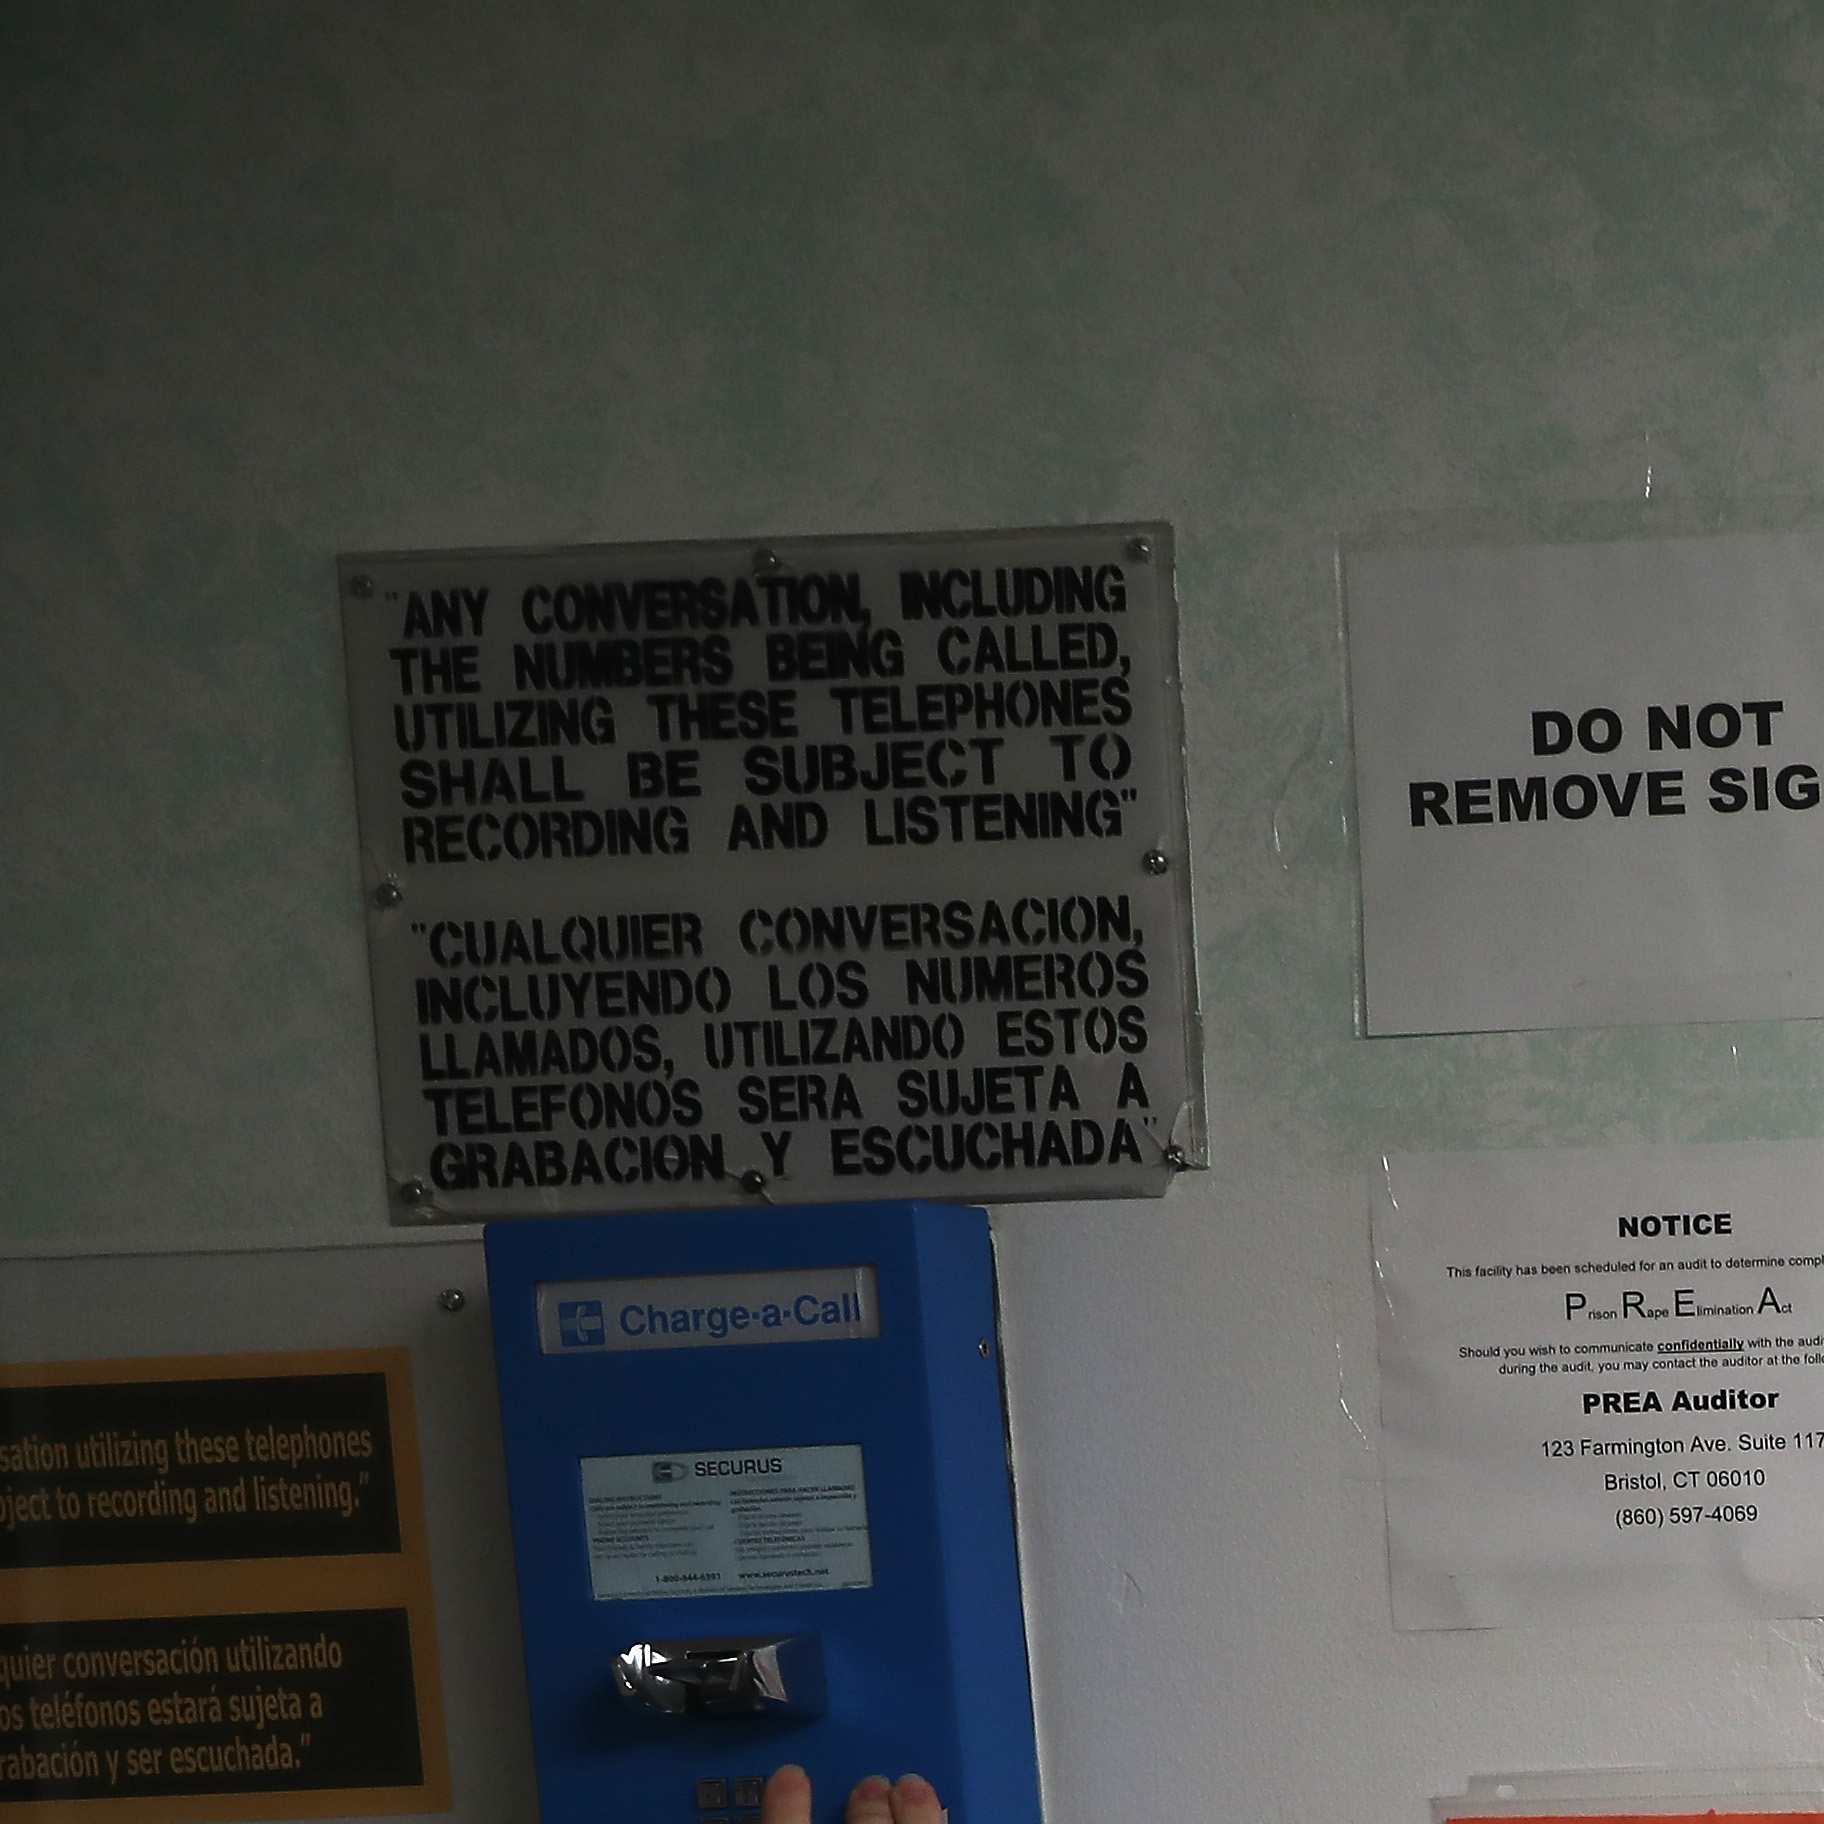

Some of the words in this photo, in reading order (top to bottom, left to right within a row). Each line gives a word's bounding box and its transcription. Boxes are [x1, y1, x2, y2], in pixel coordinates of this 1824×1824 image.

[521, 573, 870, 635] CONVERSATION,
[899, 564, 1126, 621] INCLUDING
[389, 645, 482, 696] THE
[513, 633, 734, 691] NUMBERS
[769, 630, 904, 682] BEING
[937, 621, 1130, 677] CALLED,
[393, 696, 616, 753] UTILIZING
[646, 689, 799, 742] THESE
[829, 677, 1132, 735] TELEPHONES
[1531, 708, 1622, 756] DO
[1647, 701, 1783, 751] NOT
[400, 755, 585, 810] SHALL
[627, 749, 702, 799] BE
[744, 737, 1004, 796] SUBJECT
[1049, 733, 1132, 782] TO
[1409, 770, 1686, 827] REMOVE
[402, 805, 690, 864] RECORDING
[727, 801, 828, 851] AND
[864, 788, 1137, 846] LISTENING"
[1619, 1213, 1732, 1238] NOTICE
[1446, 1266, 1472, 1278] This
[1475, 1265, 1513, 1279] facility
[1516, 1265, 1538, 1276] has
[1541, 1264, 1571, 1275] been
[1574, 1261, 1636, 1274] scheduled
[1639, 1260, 1656, 1271] for
[1659, 1262, 1674, 1271] an
[1677, 1258, 1707, 1270] audit
[1710, 1258, 1722, 1269] to
[1725, 1256, 1785, 1269] determine
[1566, 1293, 1617, 1320] Prison
[1622, 1291, 1669, 1320] Rape
[1674, 1289, 1754, 1317] Elimination
[1757, 1287, 1792, 1314] Act
[1583, 1391, 1663, 1414] PREA
[1671, 1389, 1780, 1411] Auditor
[76, 1430, 169, 1474] utilizing
[174, 1428, 240, 1465] these
[245, 1423, 372, 1469] telephones
[694, 1458, 782, 1477] SECURUS
[1542, 1440, 1574, 1457] 123
[1581, 1438, 1684, 1458] Farmington
[1690, 1436, 1731, 1452] Ave.
[1739, 1433, 1786, 1451] Suite
[56, 1486, 81, 1520] to
[87, 1479, 198, 1524] recording
[204, 1476, 247, 1514] and
[253, 1472, 369, 1517] listening."
[1605, 1472, 1666, 1491] Bristol,
[1673, 1471, 1700, 1488] CT
[1707, 1469, 1765, 1487] 06010
[1616, 1508, 1664, 1530] (860)
[1669, 1505, 1757, 1524] 597-4069
